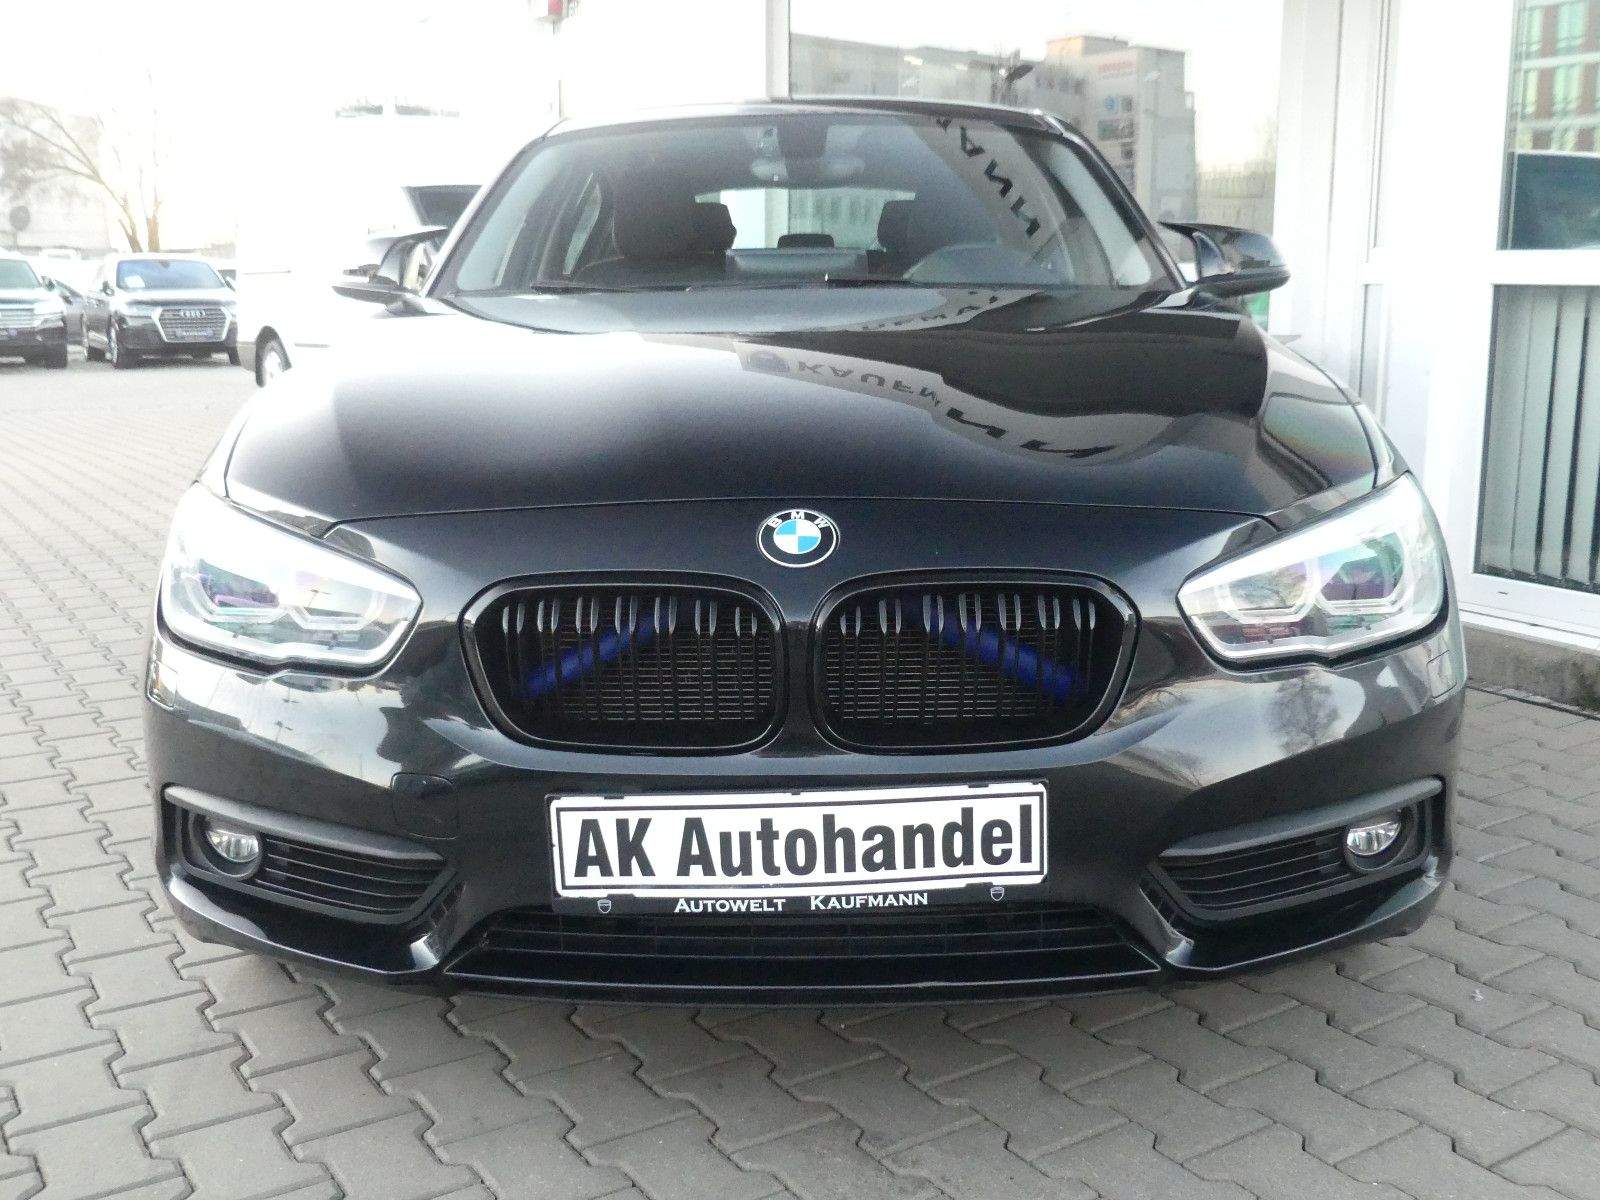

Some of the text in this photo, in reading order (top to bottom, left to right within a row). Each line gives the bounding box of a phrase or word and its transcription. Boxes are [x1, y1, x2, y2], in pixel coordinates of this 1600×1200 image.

[767, 510, 830, 529] BMW
[573, 804, 1033, 878] AK Autohandel
[674, 892, 928, 913] AUTOWELT KAUFMANN
